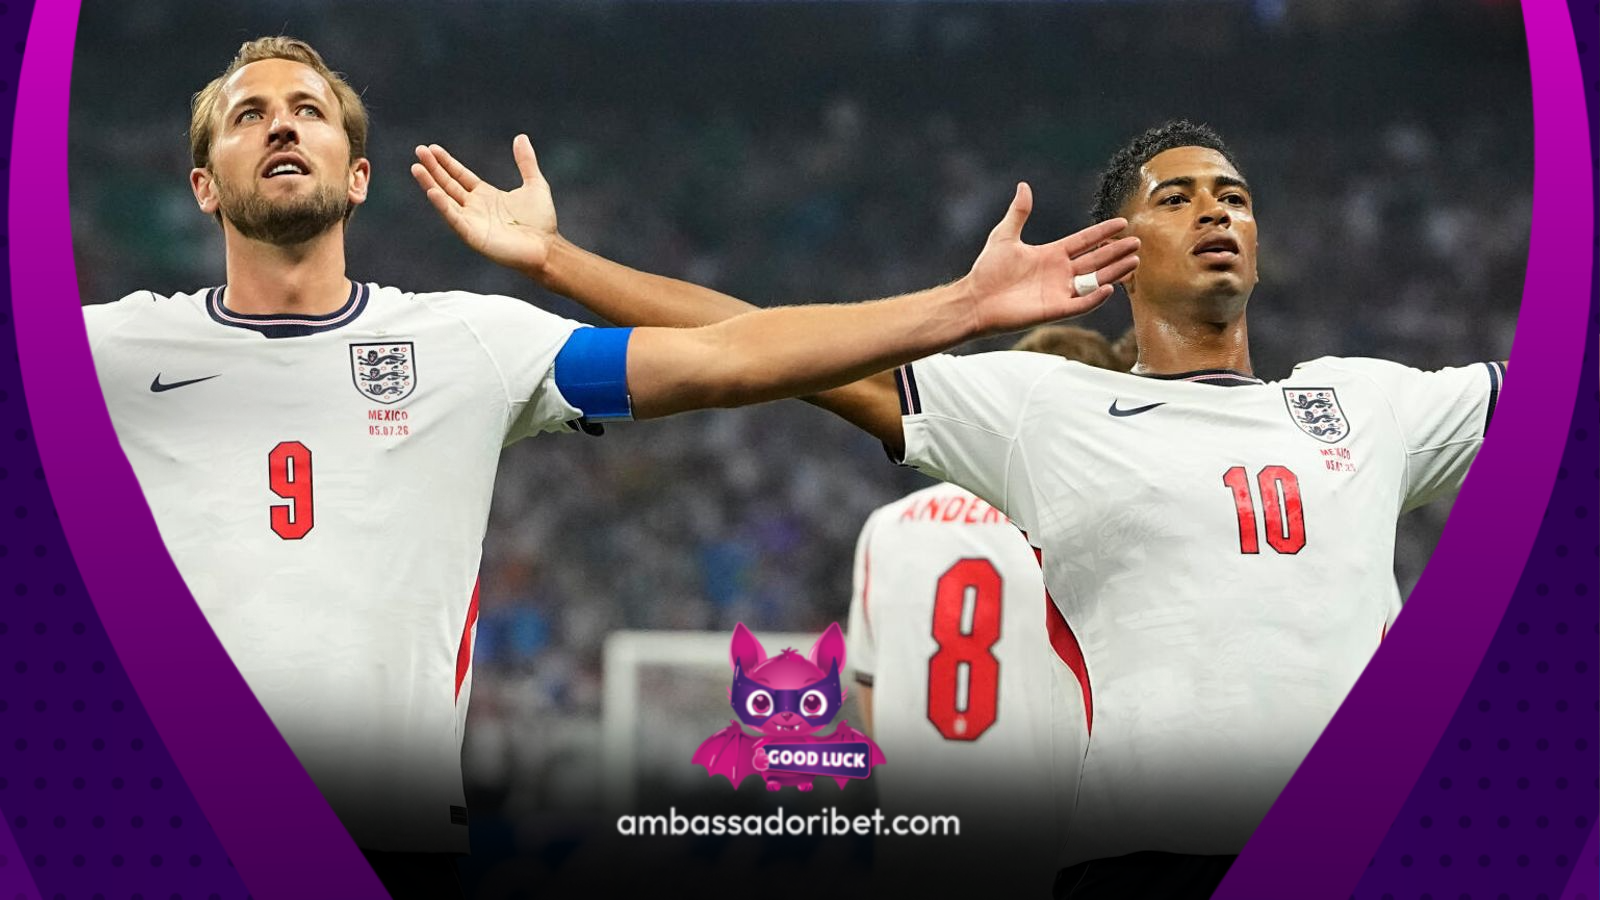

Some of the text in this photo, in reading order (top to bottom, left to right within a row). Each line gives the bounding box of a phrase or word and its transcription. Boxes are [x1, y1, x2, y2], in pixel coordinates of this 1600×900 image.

[368, 409, 408, 421] MEXICO
[369, 425, 409, 436] 05.07.26
[268, 440, 314, 540] 9
[1222, 464, 1307, 555] 10
[927, 558, 1004, 742] 8
